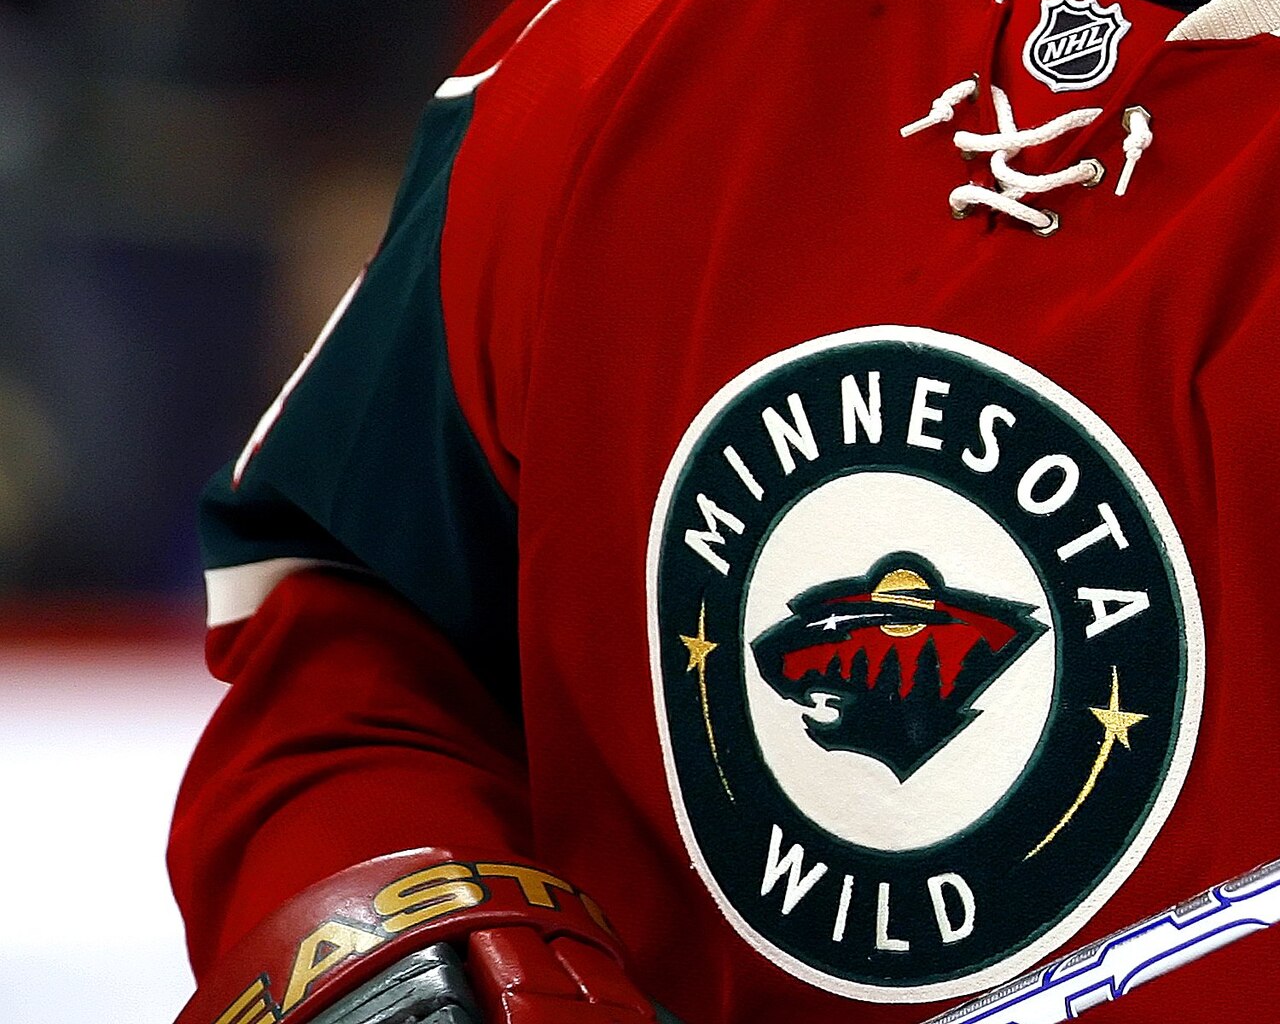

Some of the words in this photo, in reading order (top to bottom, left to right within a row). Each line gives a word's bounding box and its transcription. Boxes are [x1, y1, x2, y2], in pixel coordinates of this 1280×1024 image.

[1042, 25, 1103, 63] NHL
[683, 370, 1150, 638] MINNESOTA
[760, 823, 976, 953] WILD
